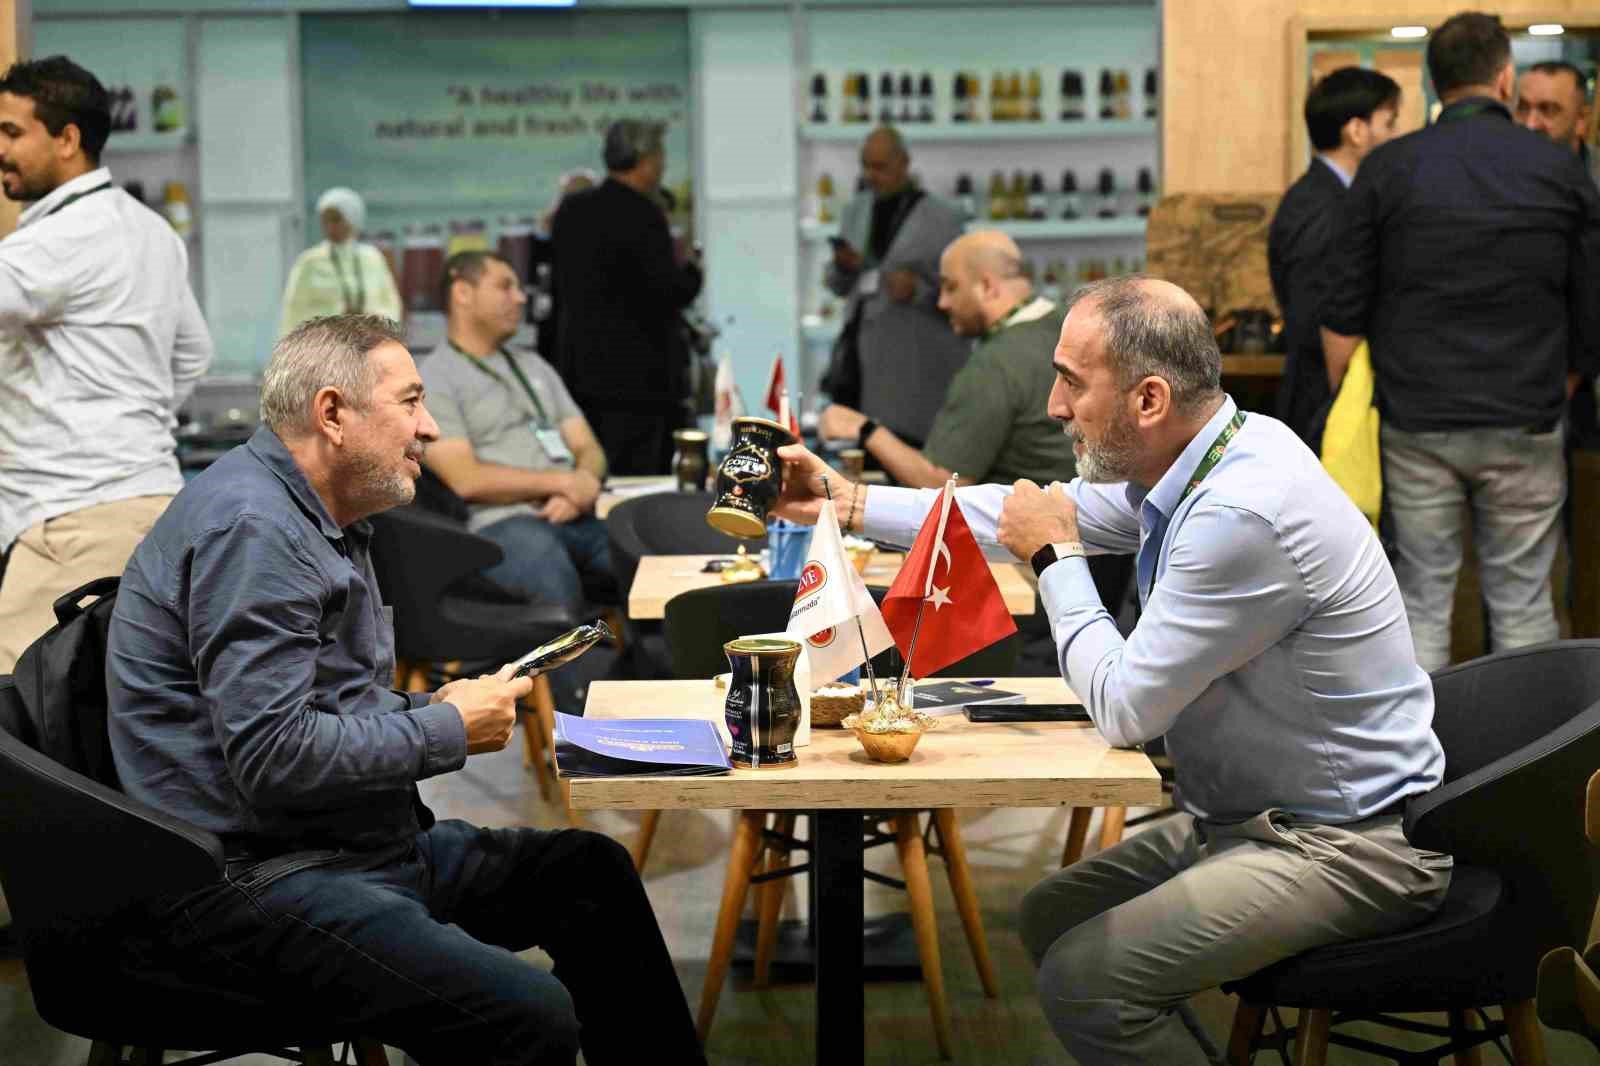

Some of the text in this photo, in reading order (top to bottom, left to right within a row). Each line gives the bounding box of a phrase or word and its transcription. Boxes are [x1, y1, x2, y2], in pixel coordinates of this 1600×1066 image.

[481, 84, 573, 109] healthy
[627, 80, 684, 104] with
[375, 115, 465, 139] natural
[474, 115, 516, 138] and
[524, 113, 588, 136] fresh
